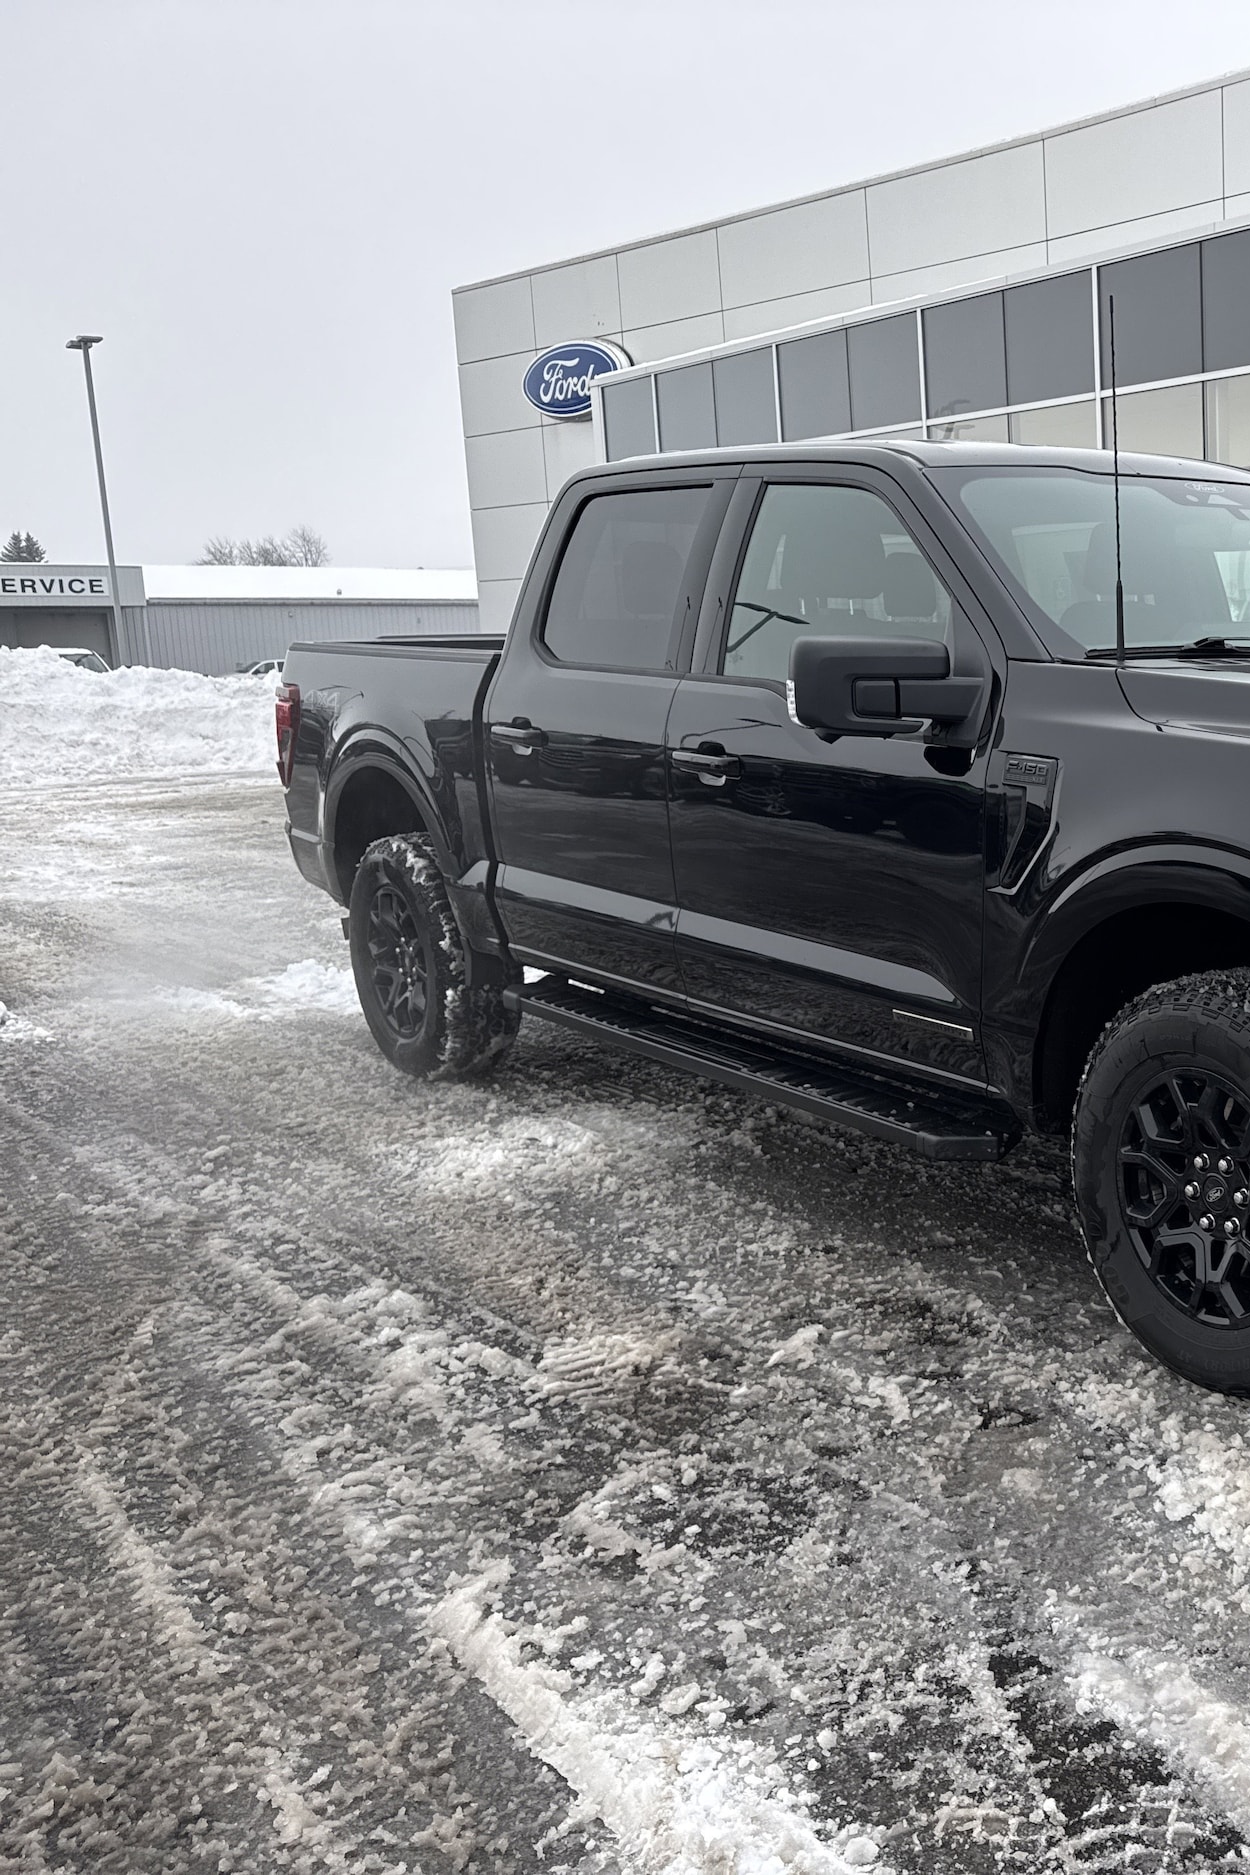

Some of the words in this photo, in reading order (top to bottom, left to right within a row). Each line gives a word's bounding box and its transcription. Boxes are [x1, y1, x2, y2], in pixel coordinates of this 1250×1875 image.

[540, 357, 595, 403] Ford
[1, 578, 104, 594] ERVICE
[1006, 760, 1048, 775] F-150
